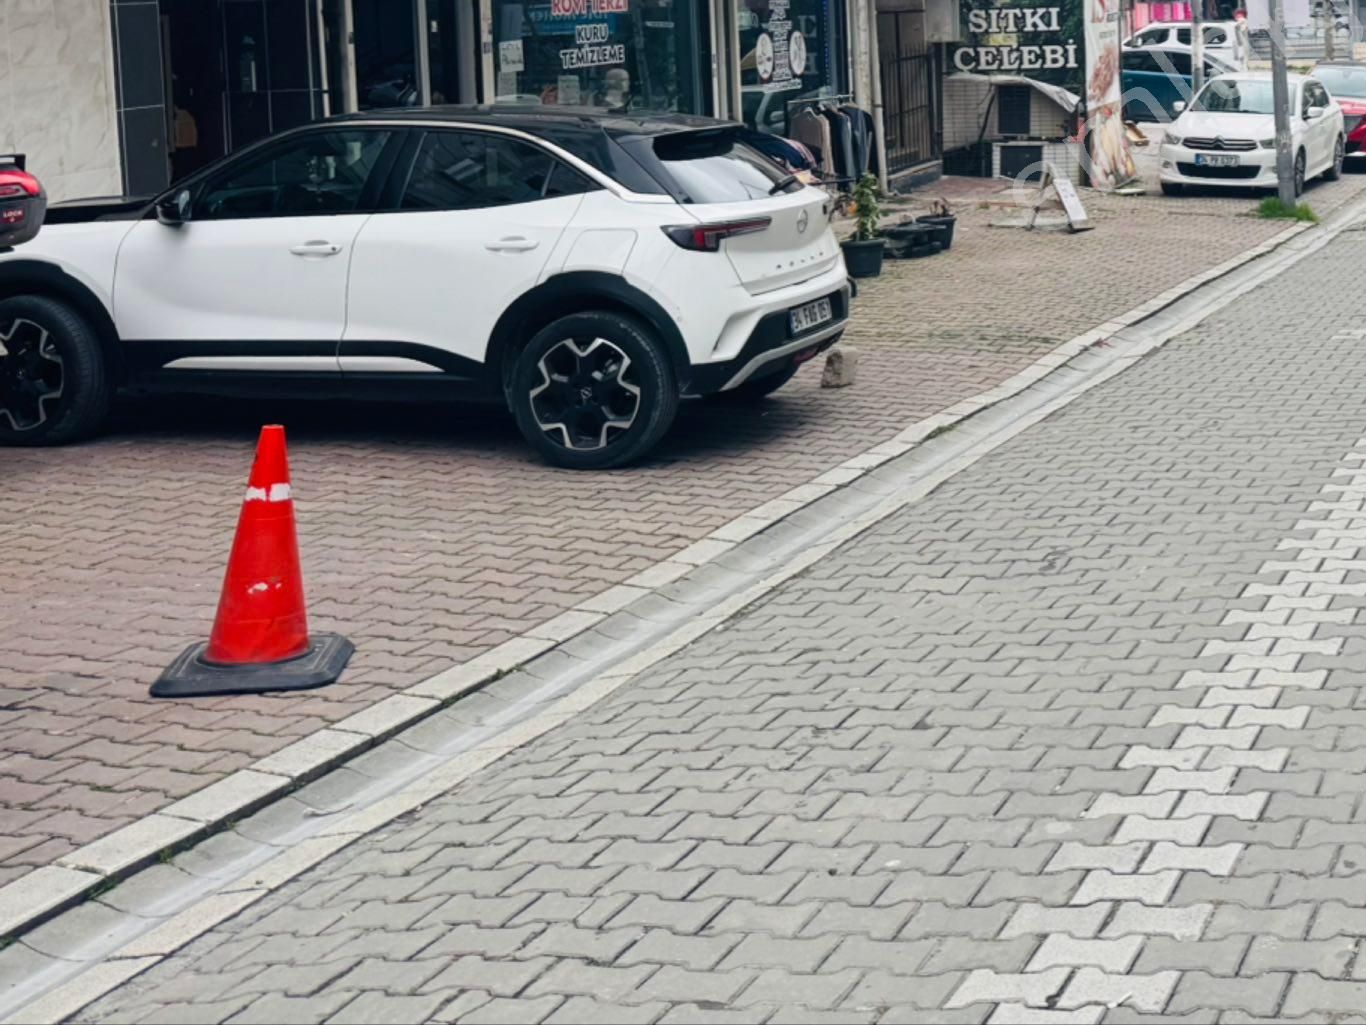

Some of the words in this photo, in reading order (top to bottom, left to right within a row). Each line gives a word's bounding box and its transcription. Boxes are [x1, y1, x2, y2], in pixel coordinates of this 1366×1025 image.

[968, 7, 1061, 33] SITKI
[575, 24, 610, 44] KURU
[560, 43, 625, 69] TEMİZLEME
[953, 38, 1079, 74] ÇELEBİ
